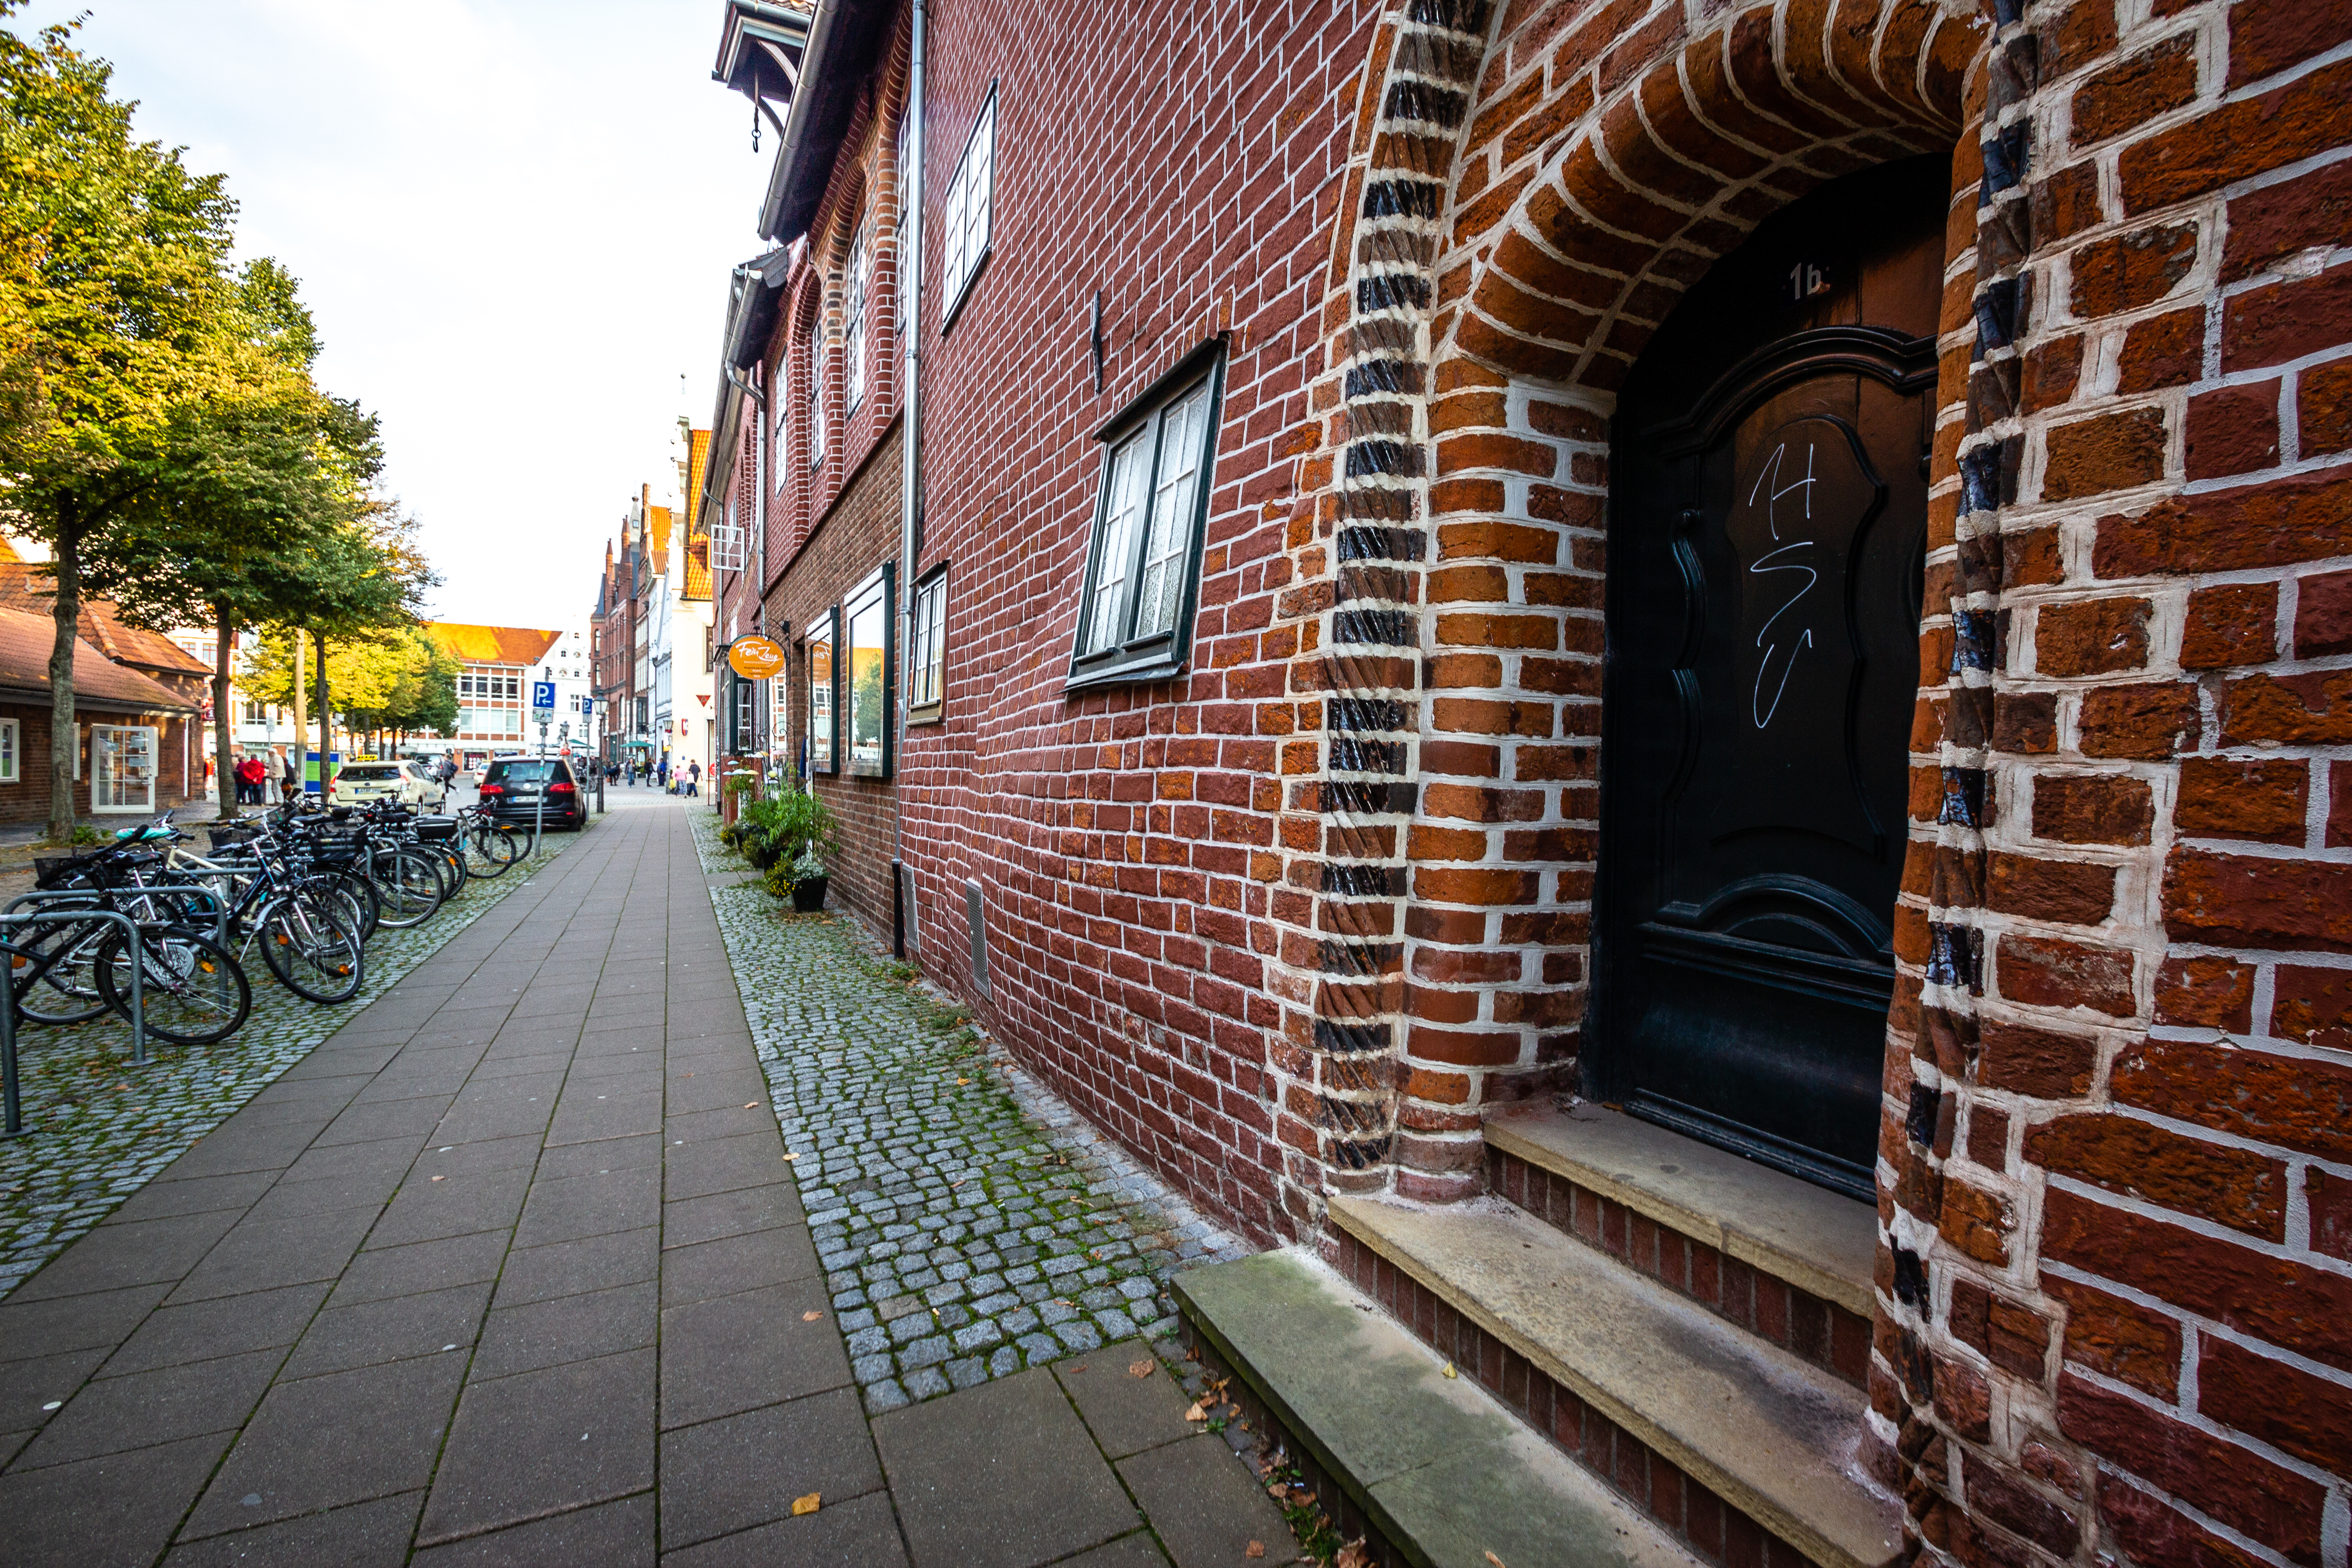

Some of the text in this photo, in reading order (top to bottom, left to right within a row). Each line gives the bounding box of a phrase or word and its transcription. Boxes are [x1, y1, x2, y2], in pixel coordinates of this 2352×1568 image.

[1790, 263, 1821, 300] 1b
[536, 685, 549, 704] P
[584, 700, 590, 712] P
